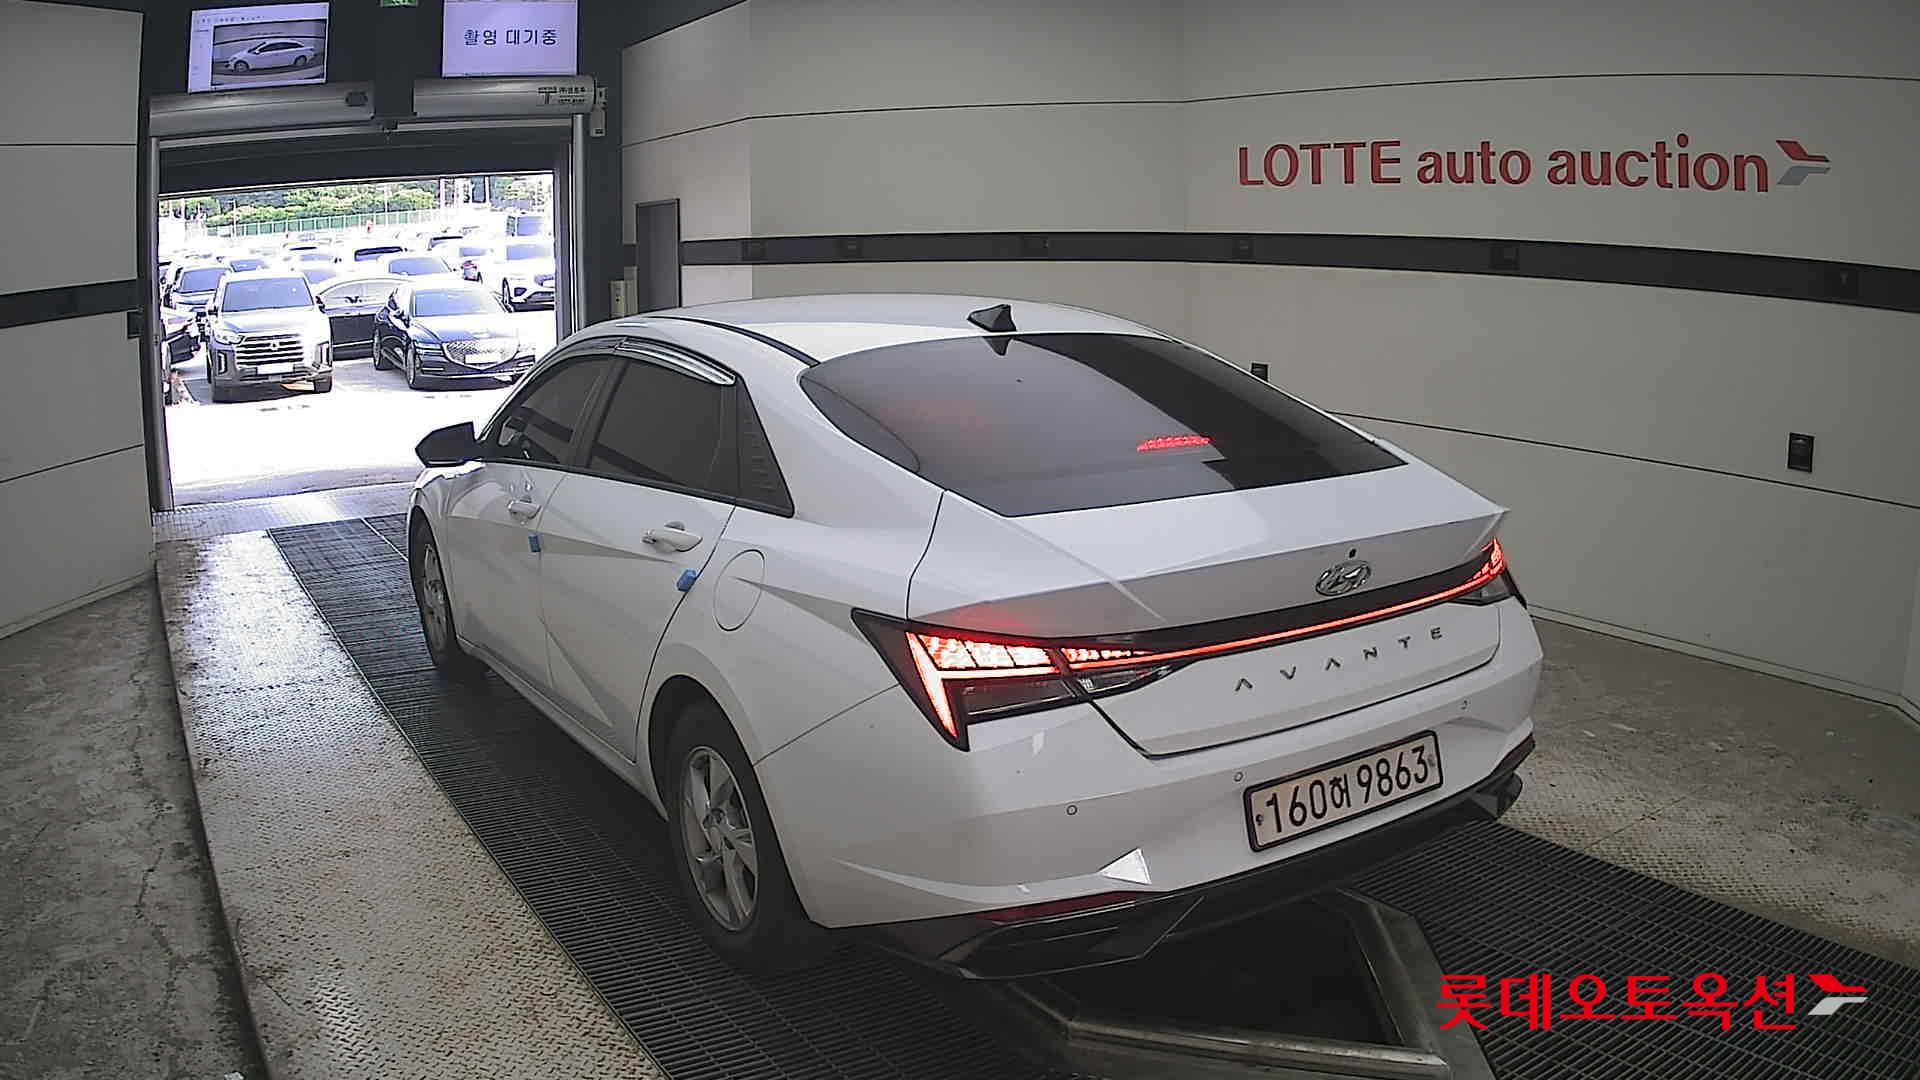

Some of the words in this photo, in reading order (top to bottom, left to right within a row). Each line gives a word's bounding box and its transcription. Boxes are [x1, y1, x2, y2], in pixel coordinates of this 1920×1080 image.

[464, 29, 498, 46] 촬영
[505, 28, 558, 46] 대기중
[1239, 141, 1401, 187] LOTTE
[1417, 141, 1532, 185] auto
[1547, 133, 1770, 193] auction
[1234, 626, 1444, 692] AVANTE
